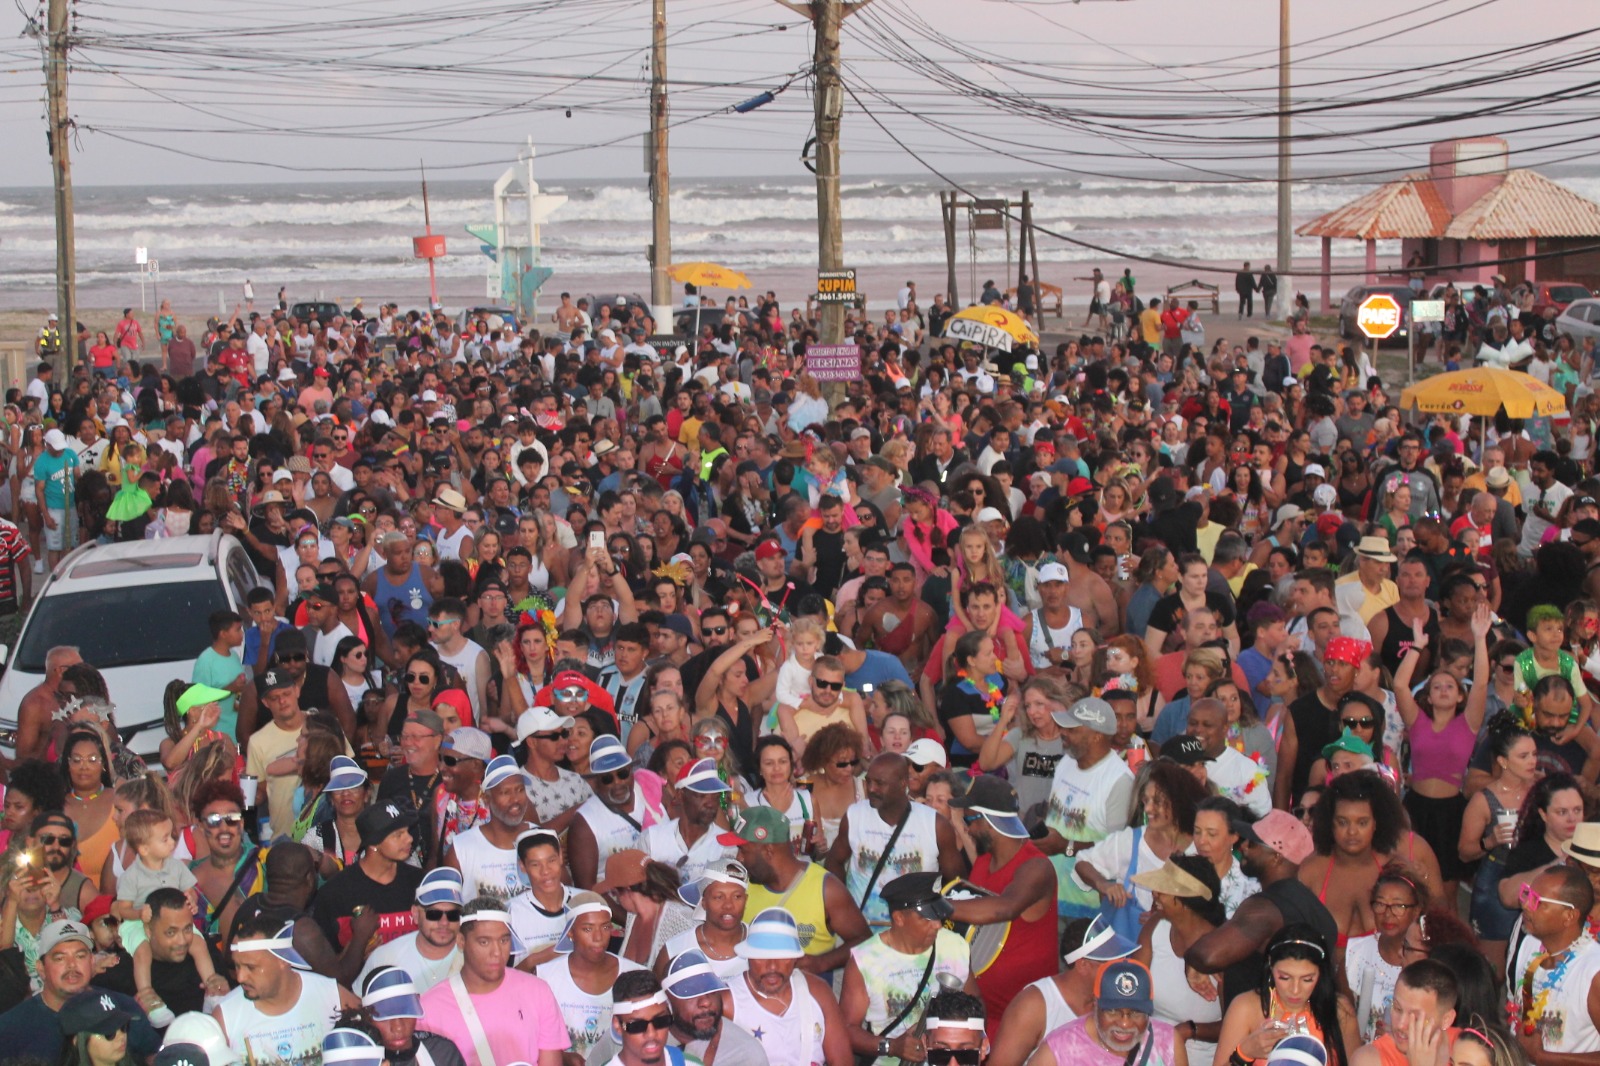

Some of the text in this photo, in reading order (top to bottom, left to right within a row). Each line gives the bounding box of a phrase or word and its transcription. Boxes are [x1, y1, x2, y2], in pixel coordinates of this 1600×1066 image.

[818, 279, 855, 292] CUPIM
[1361, 307, 1396, 325] PARE
[807, 358, 858, 368] PERSIANAS
[1181, 740, 1203, 752] NYC
[1026, 756, 1054, 771] ONL
